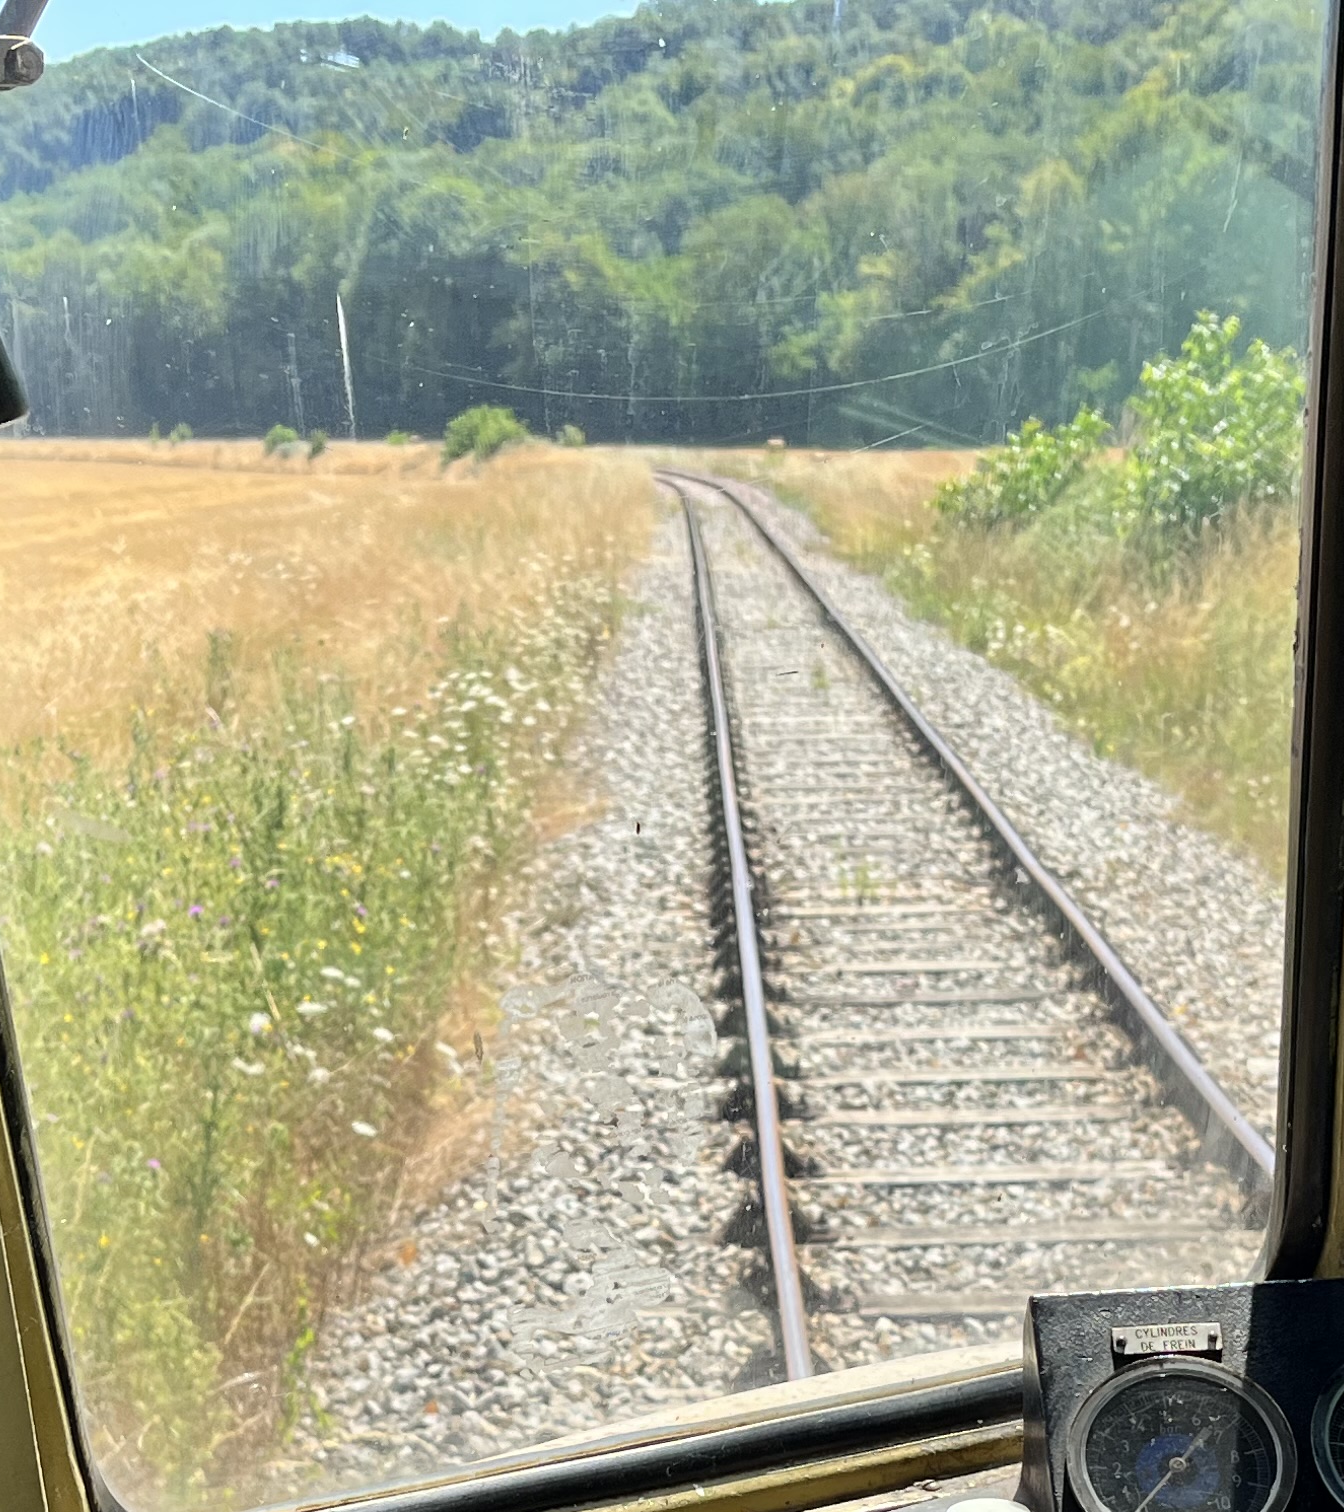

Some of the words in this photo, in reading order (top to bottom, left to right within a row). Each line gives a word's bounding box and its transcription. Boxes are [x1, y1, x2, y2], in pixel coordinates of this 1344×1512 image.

[1133, 1325, 1198, 1339] CYLINDRES
[1141, 1340, 1156, 1351] DE
[1160, 1336, 1197, 1350] FREIN
